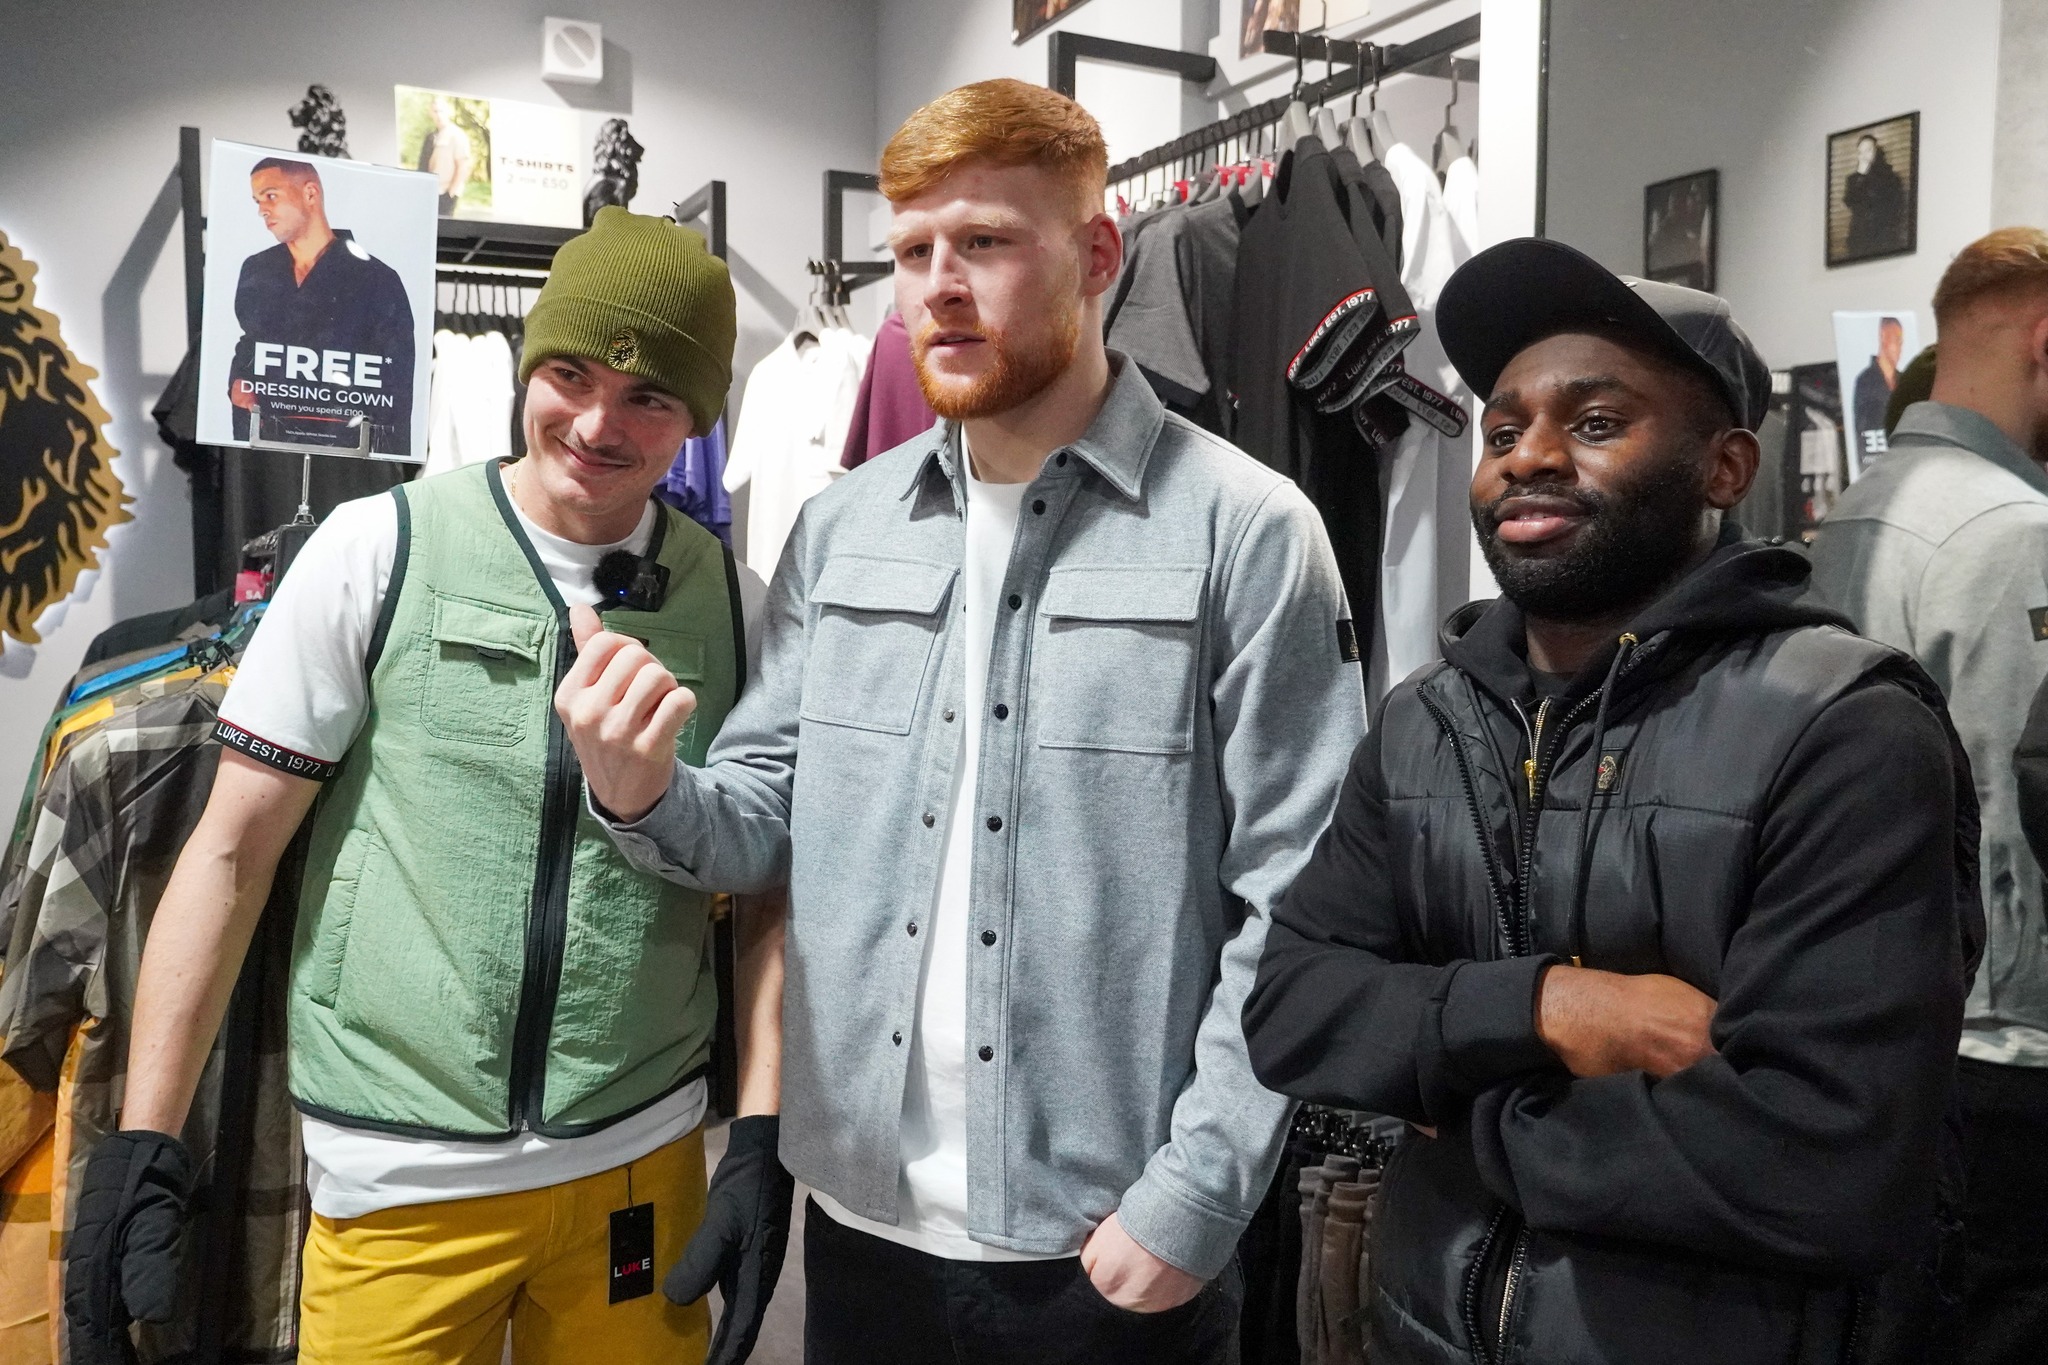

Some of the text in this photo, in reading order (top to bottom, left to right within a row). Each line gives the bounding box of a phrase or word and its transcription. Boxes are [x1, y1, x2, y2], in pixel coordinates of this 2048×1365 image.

[500, 156, 575, 173] T-SHIRTS
[507, 173, 514, 183] 2
[542, 177, 568, 190] £50
[1304, 326, 1325, 352] LUKE
[1324, 306, 1346, 328] EST.
[1345, 291, 1373, 309] 1977
[240, 380, 394, 408] DRESSING GOWN
[270, 401, 297, 411] When
[298, 405, 315, 413] you
[316, 407, 343, 417] spend
[216, 723, 249, 747] LUKE
[249, 739, 282, 763] EST.
[287, 755, 321, 775] 1977
[614, 1257, 651, 1278] LUKE
